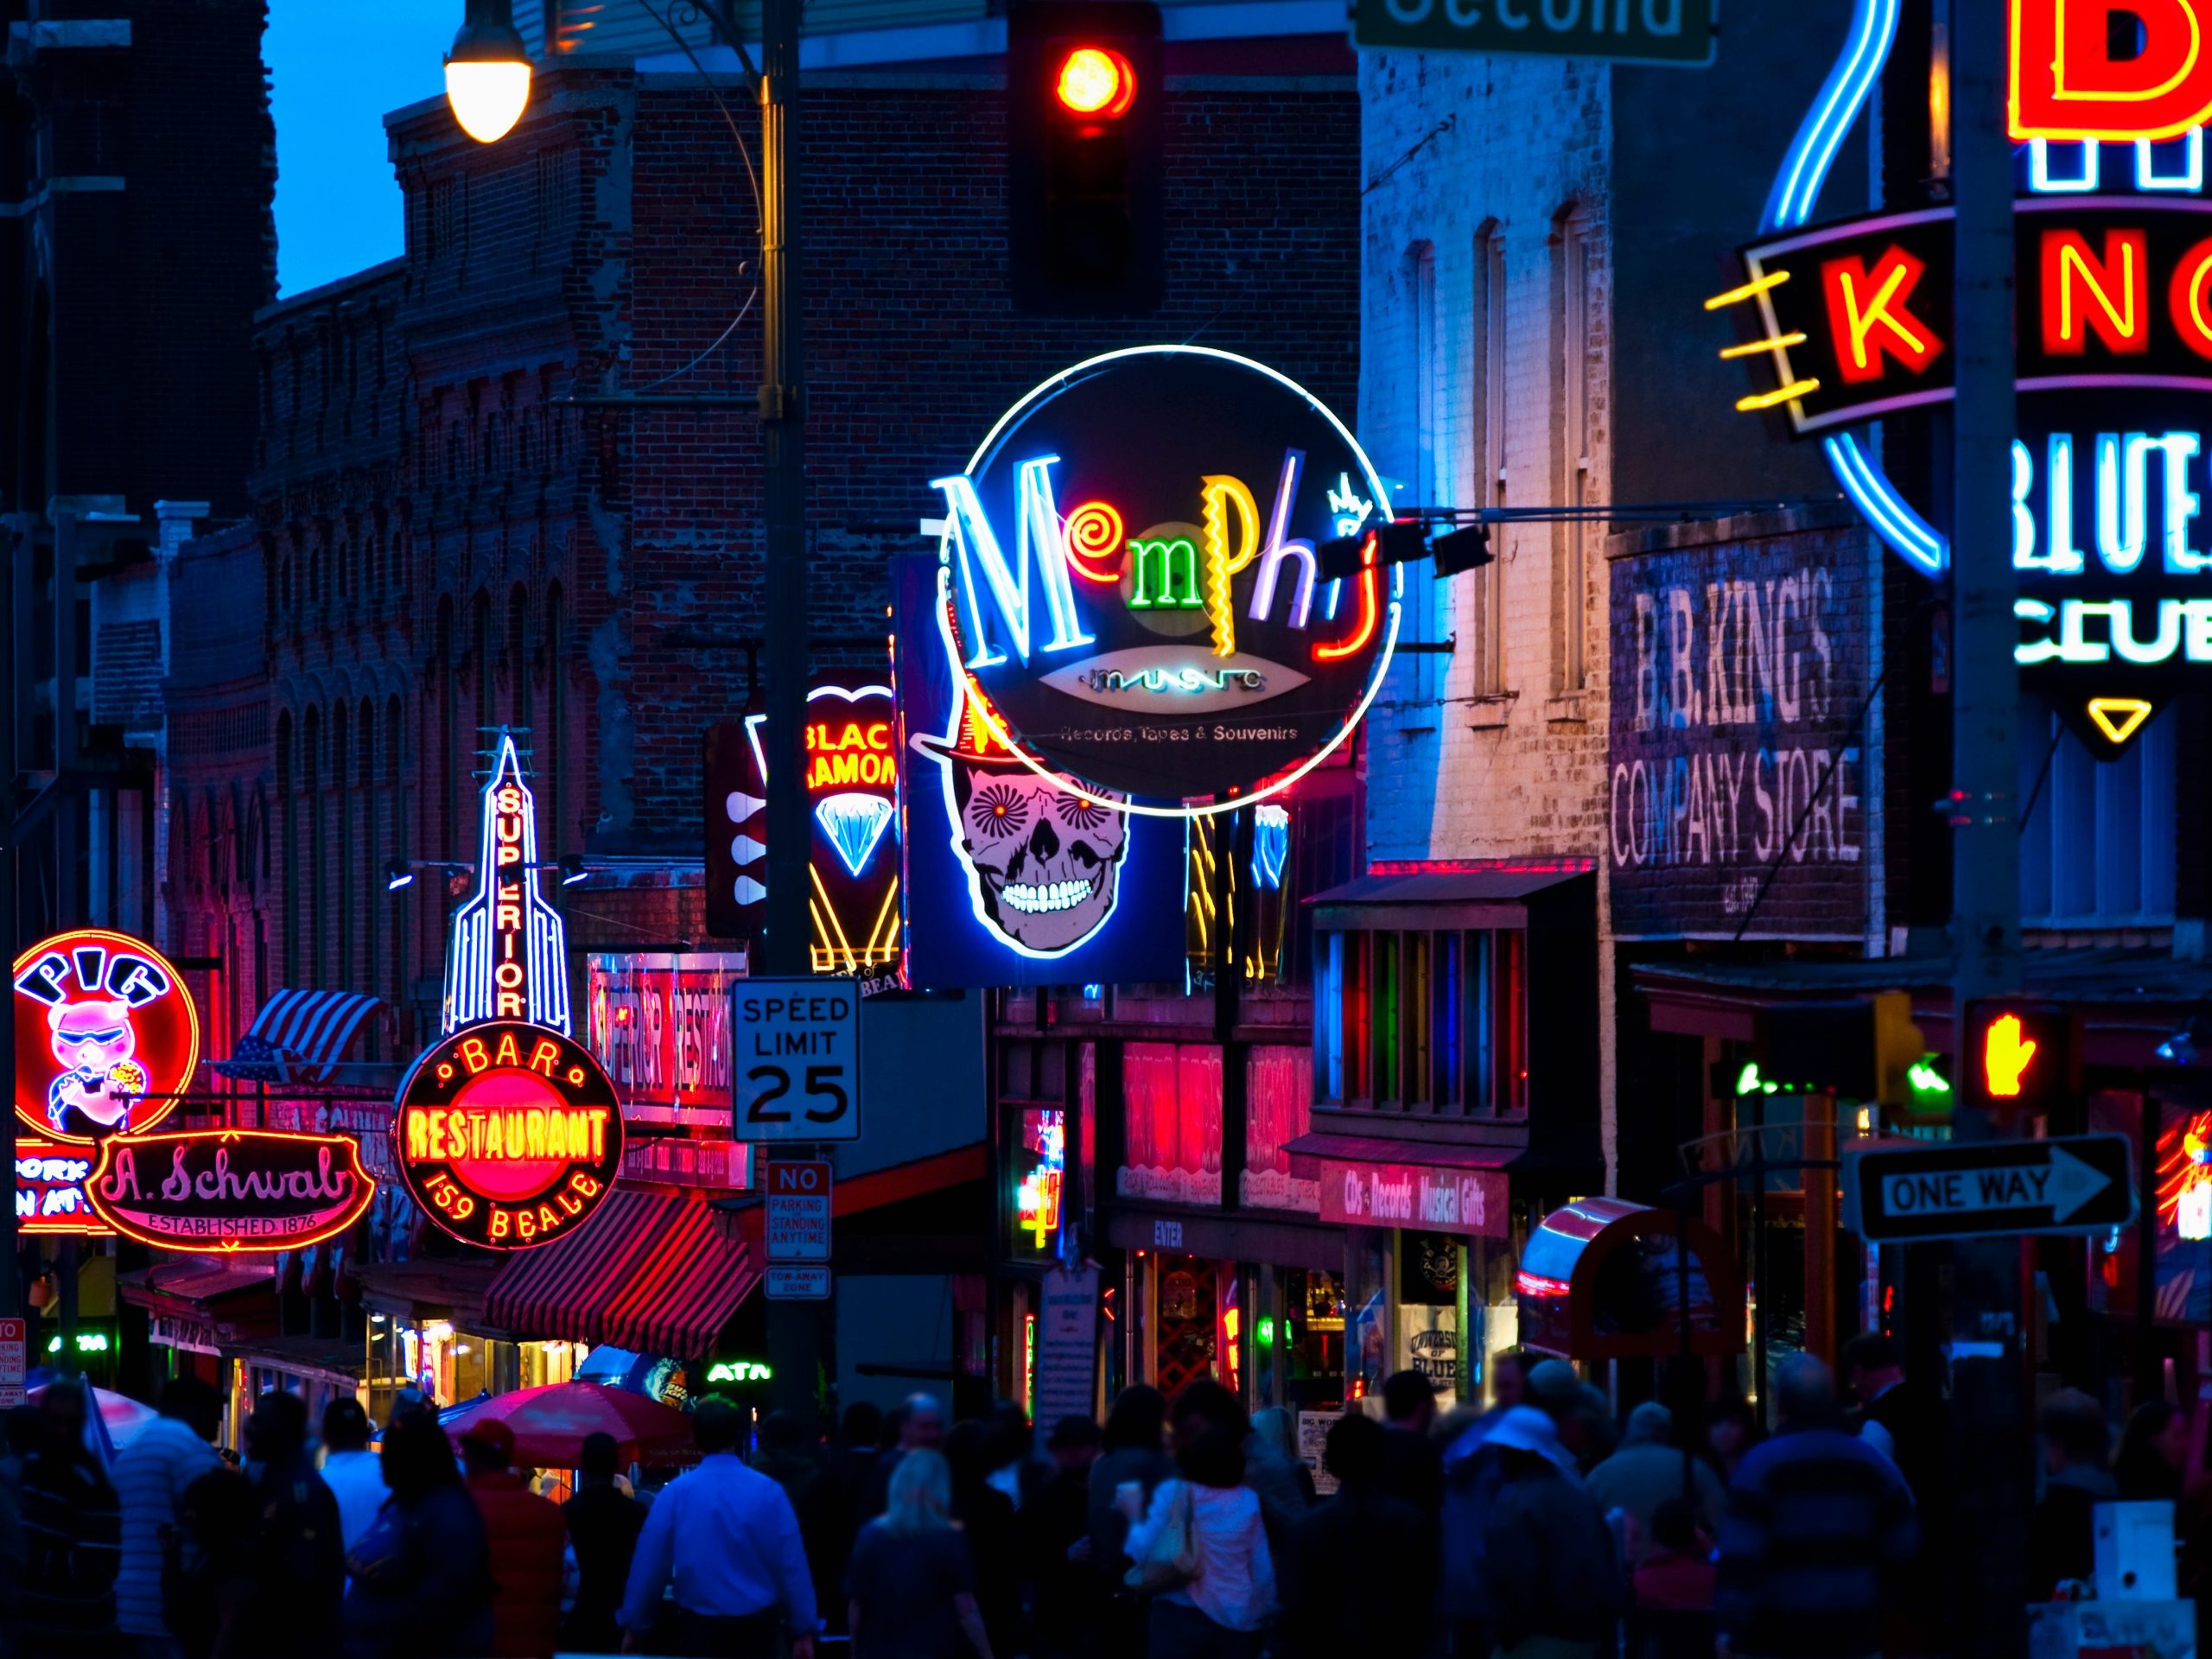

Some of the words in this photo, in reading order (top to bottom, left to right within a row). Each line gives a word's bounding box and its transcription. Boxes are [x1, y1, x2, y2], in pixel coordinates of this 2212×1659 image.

[1213, 725, 1298, 741] Souvenirs
[1611, 750, 1746, 868] COMPANY
[1755, 745, 1860, 863] STORE
[495, 787, 523, 1017] SUPERIOR
[14, 947, 171, 1008] PIG
[743, 997, 849, 1022] SPEED
[459, 1033, 559, 1078] BAR
[755, 1032, 837, 1056] LIMIT
[747, 1065, 848, 1123] 25
[407, 1106, 610, 1161] RESTAURANT
[99, 1147, 155, 1201] A.
[162, 1146, 354, 1201] Schwab
[779, 1168, 818, 1190] NO
[423, 1172, 474, 1221] 159
[489, 1170, 600, 1239] BEALE
[772, 1199, 822, 1211] PARKING
[1371, 1172, 1412, 1220] Records
[1420, 1173, 1460, 1224] Musical
[1462, 1175, 1485, 1227] Gifts
[1892, 1175, 1965, 1211] ONE
[1979, 1169, 2052, 1205] WAY
[149, 1214, 276, 1236] ESTABLISHED
[282, 1214, 317, 1234] 1876
[772, 1217, 825, 1230] STANDING
[772, 1232, 825, 1245] ANYTIME
[1154, 1219, 1183, 1249] ENTER
[783, 1283, 811, 1293] ZONE
[797, 1273, 824, 1281] AWAY
